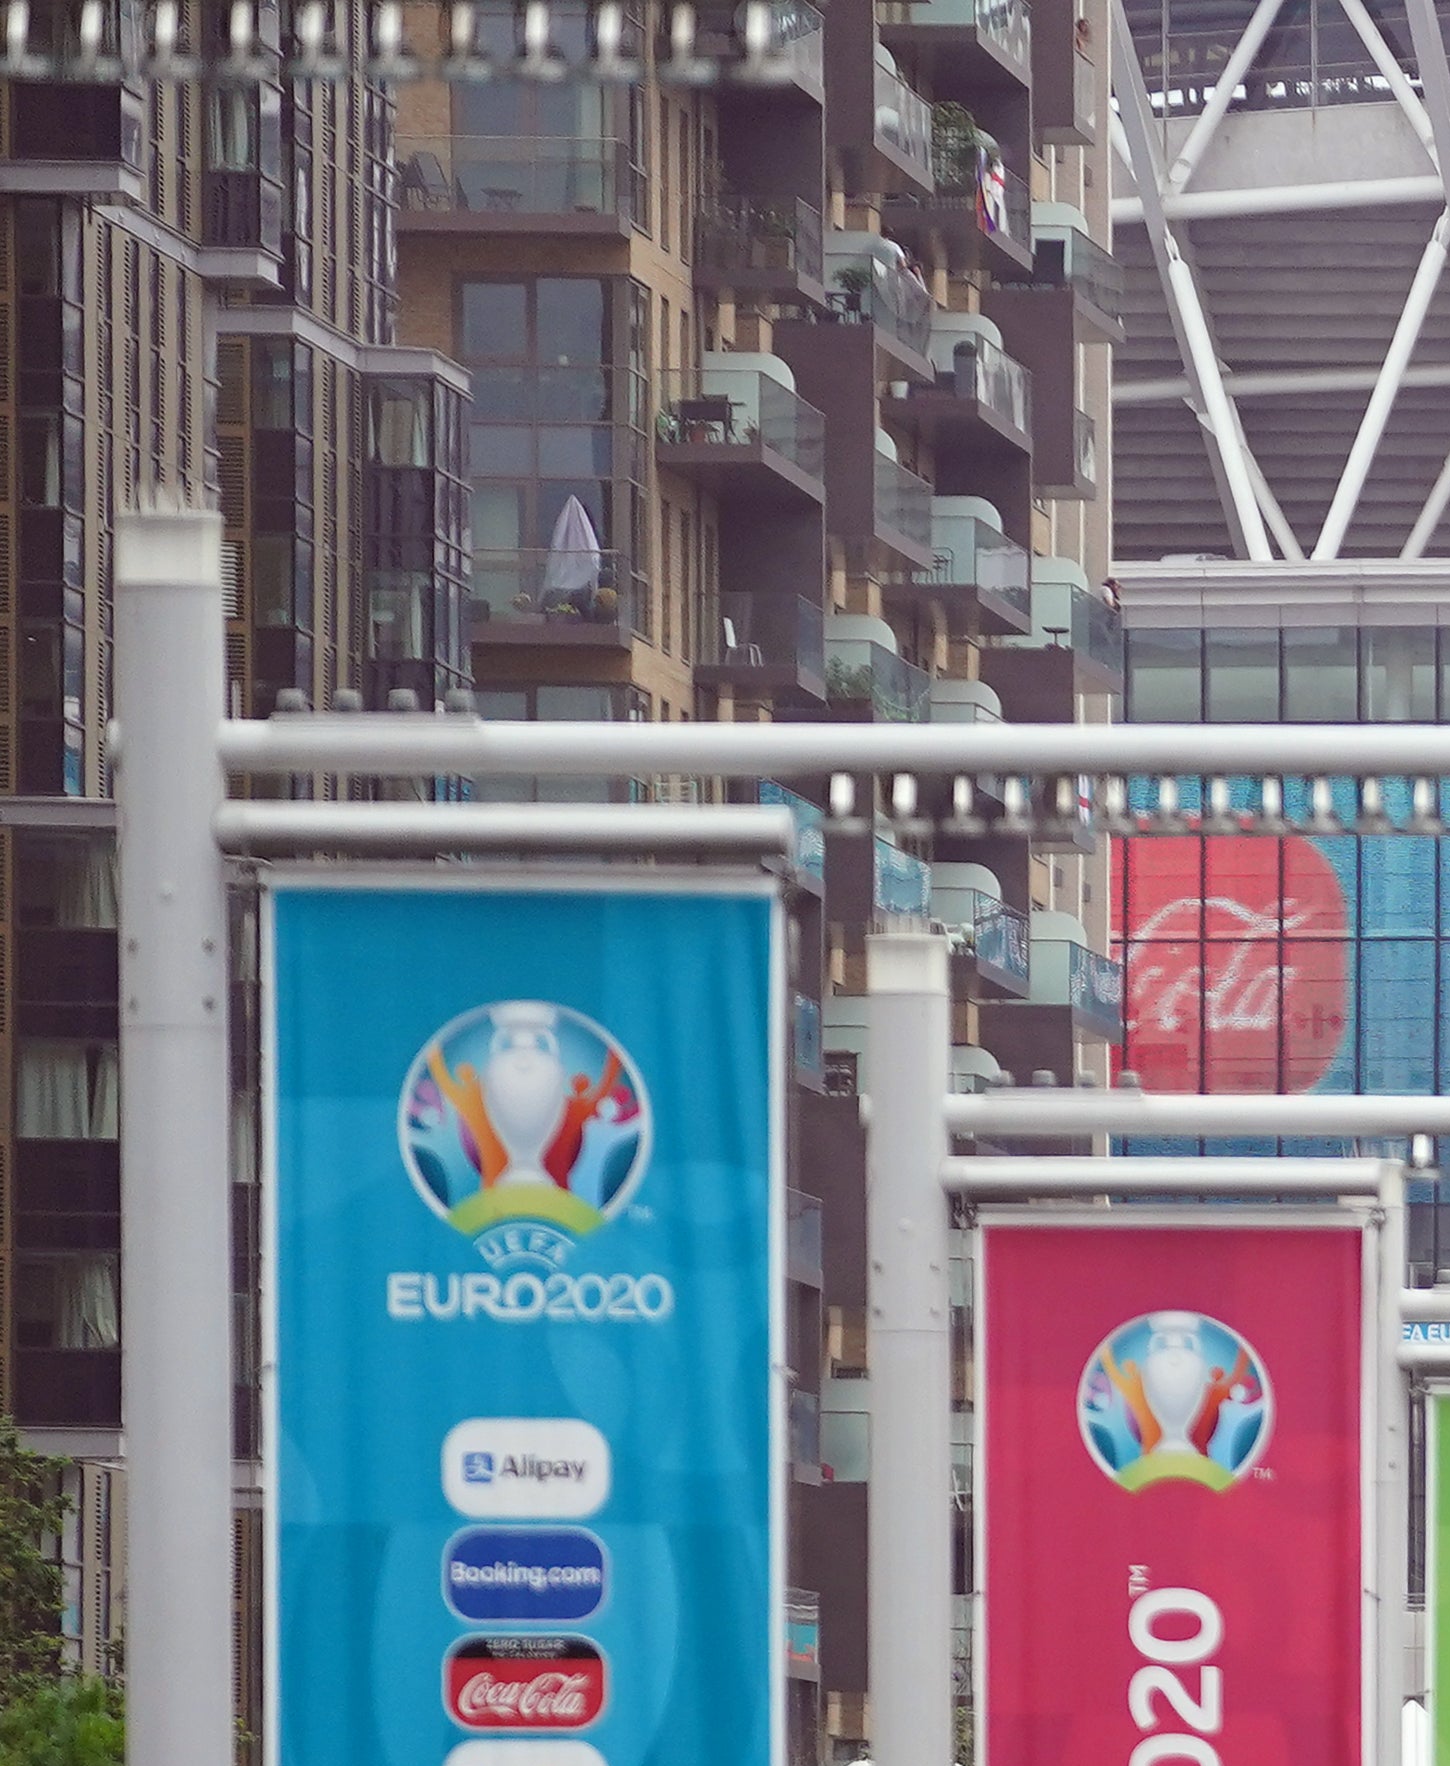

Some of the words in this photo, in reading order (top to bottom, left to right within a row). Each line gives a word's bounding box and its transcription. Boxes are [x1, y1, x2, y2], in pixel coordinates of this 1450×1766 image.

[477, 1229, 568, 1263] UEFA
[387, 1271, 675, 1322] EURO2020
[499, 1455, 587, 1482] Alipay
[450, 1560, 600, 1587] Booking.com
